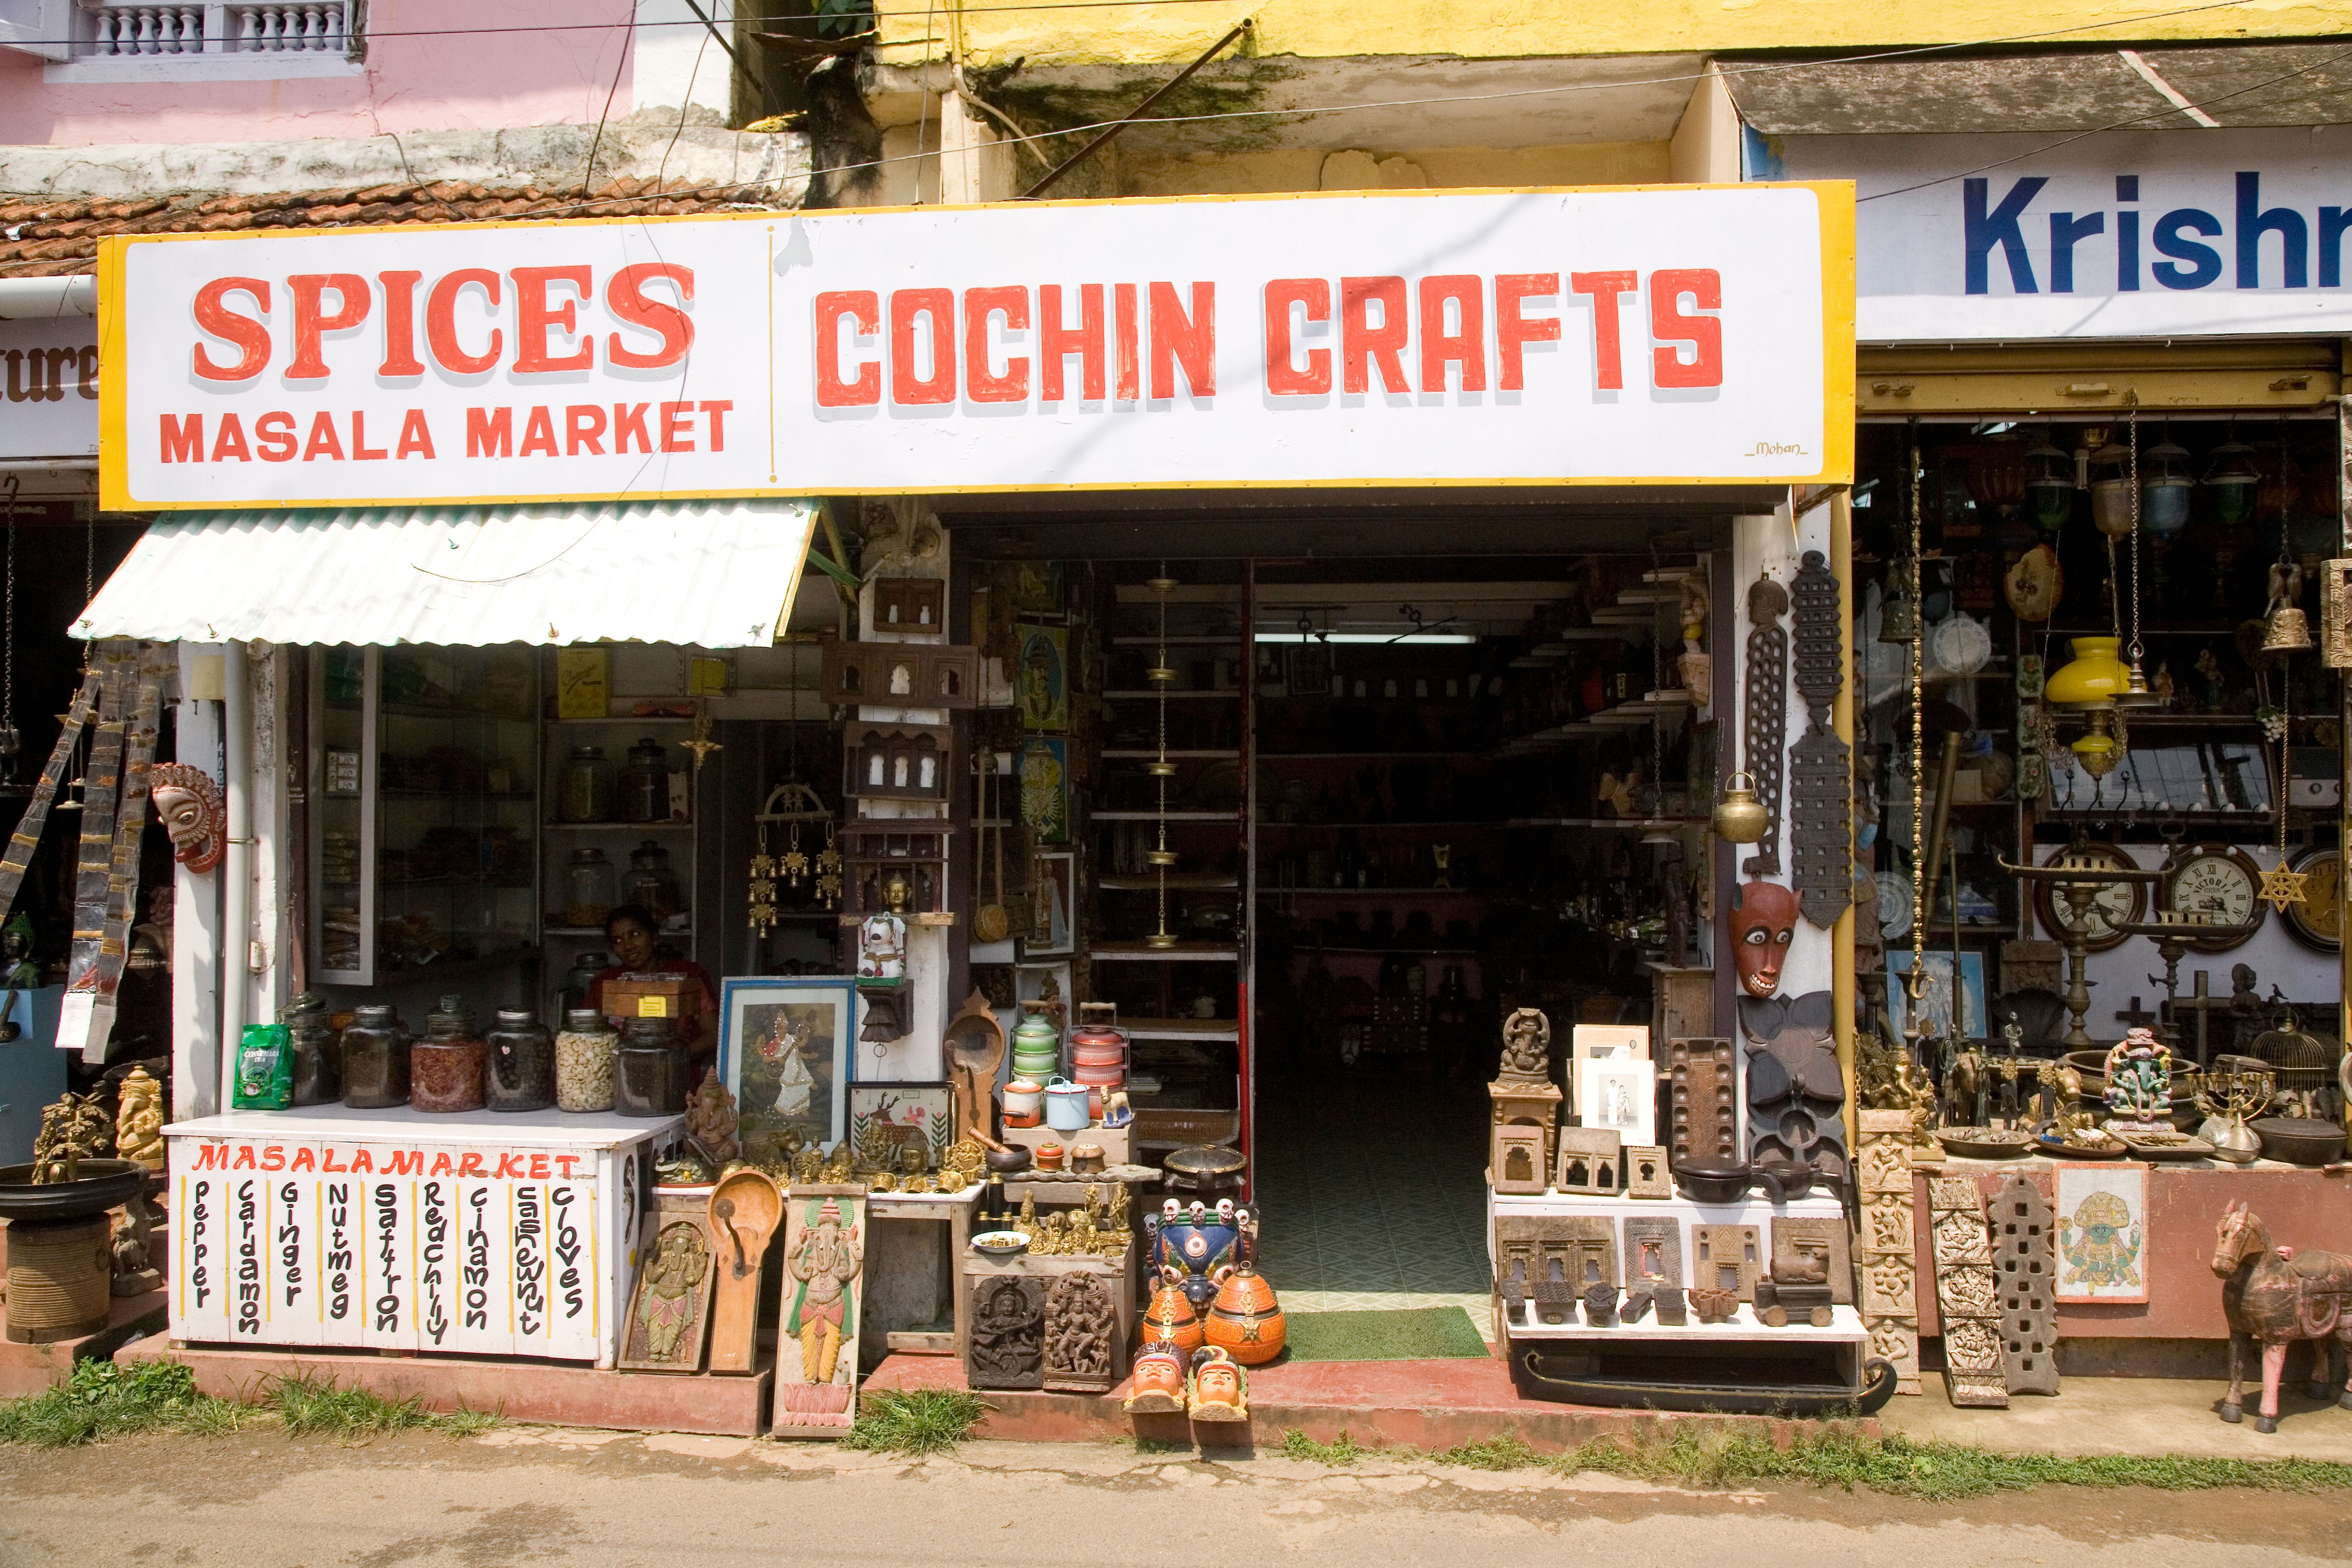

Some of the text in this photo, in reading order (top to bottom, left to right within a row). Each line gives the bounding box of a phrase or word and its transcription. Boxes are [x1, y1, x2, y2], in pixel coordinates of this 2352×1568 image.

[0, 345, 98, 403] ure
[192, 263, 695, 382] SPICES
[815, 269, 1724, 407] COCHIN CRAFTS
[160, 400, 733, 463] MASALA MARKET
[2193, 877, 2232, 894] VICTORIA
[279, 1182, 302, 1307] Ginger
[328, 1183, 352, 1320] Nutmeg
[375, 1184, 401, 1333] Saffron
